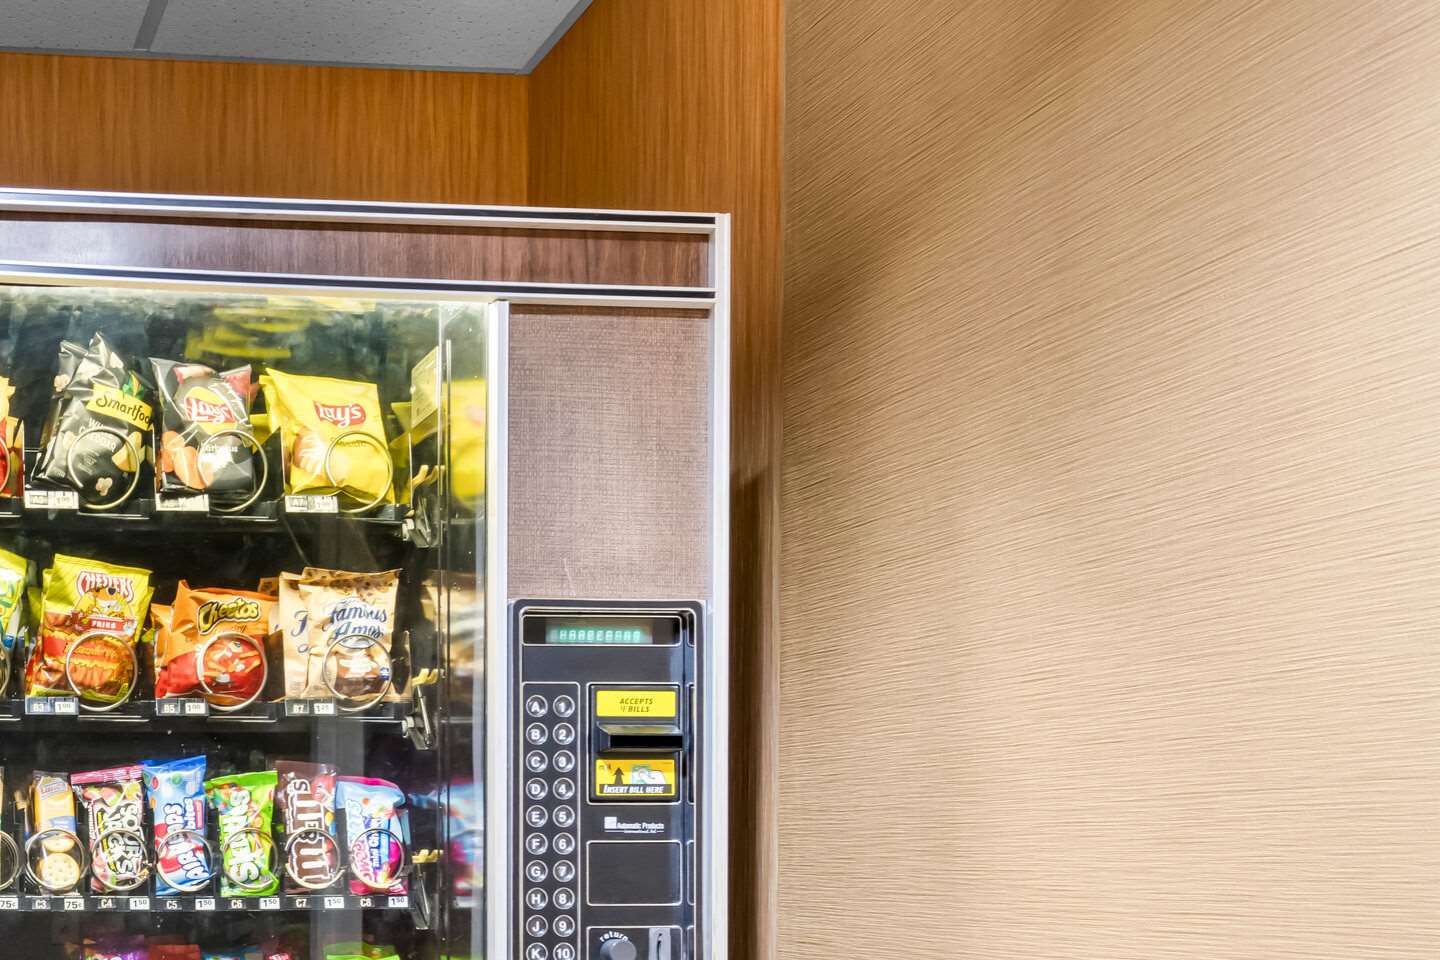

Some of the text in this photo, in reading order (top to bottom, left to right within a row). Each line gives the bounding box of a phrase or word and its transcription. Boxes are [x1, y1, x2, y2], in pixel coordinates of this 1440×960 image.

[319, 403, 363, 428] Lay's
[198, 599, 259, 633] Cheetos
[531, 701, 566, 713] A 1
[530, 728, 567, 740] B 2
[530, 756, 541, 768] C
[530, 783, 567, 795] D 4
[530, 811, 567, 823] E 5
[616, 821, 665, 830] Automatic Products
[530, 838, 567, 850] F 6
[530, 865, 567, 877] G 7
[166, 900, 178, 909] C5
[530, 893, 567, 905] H 8
[531, 920, 567, 932] J 9
[599, 930, 629, 942] return
[530, 948, 571, 960] K 10
